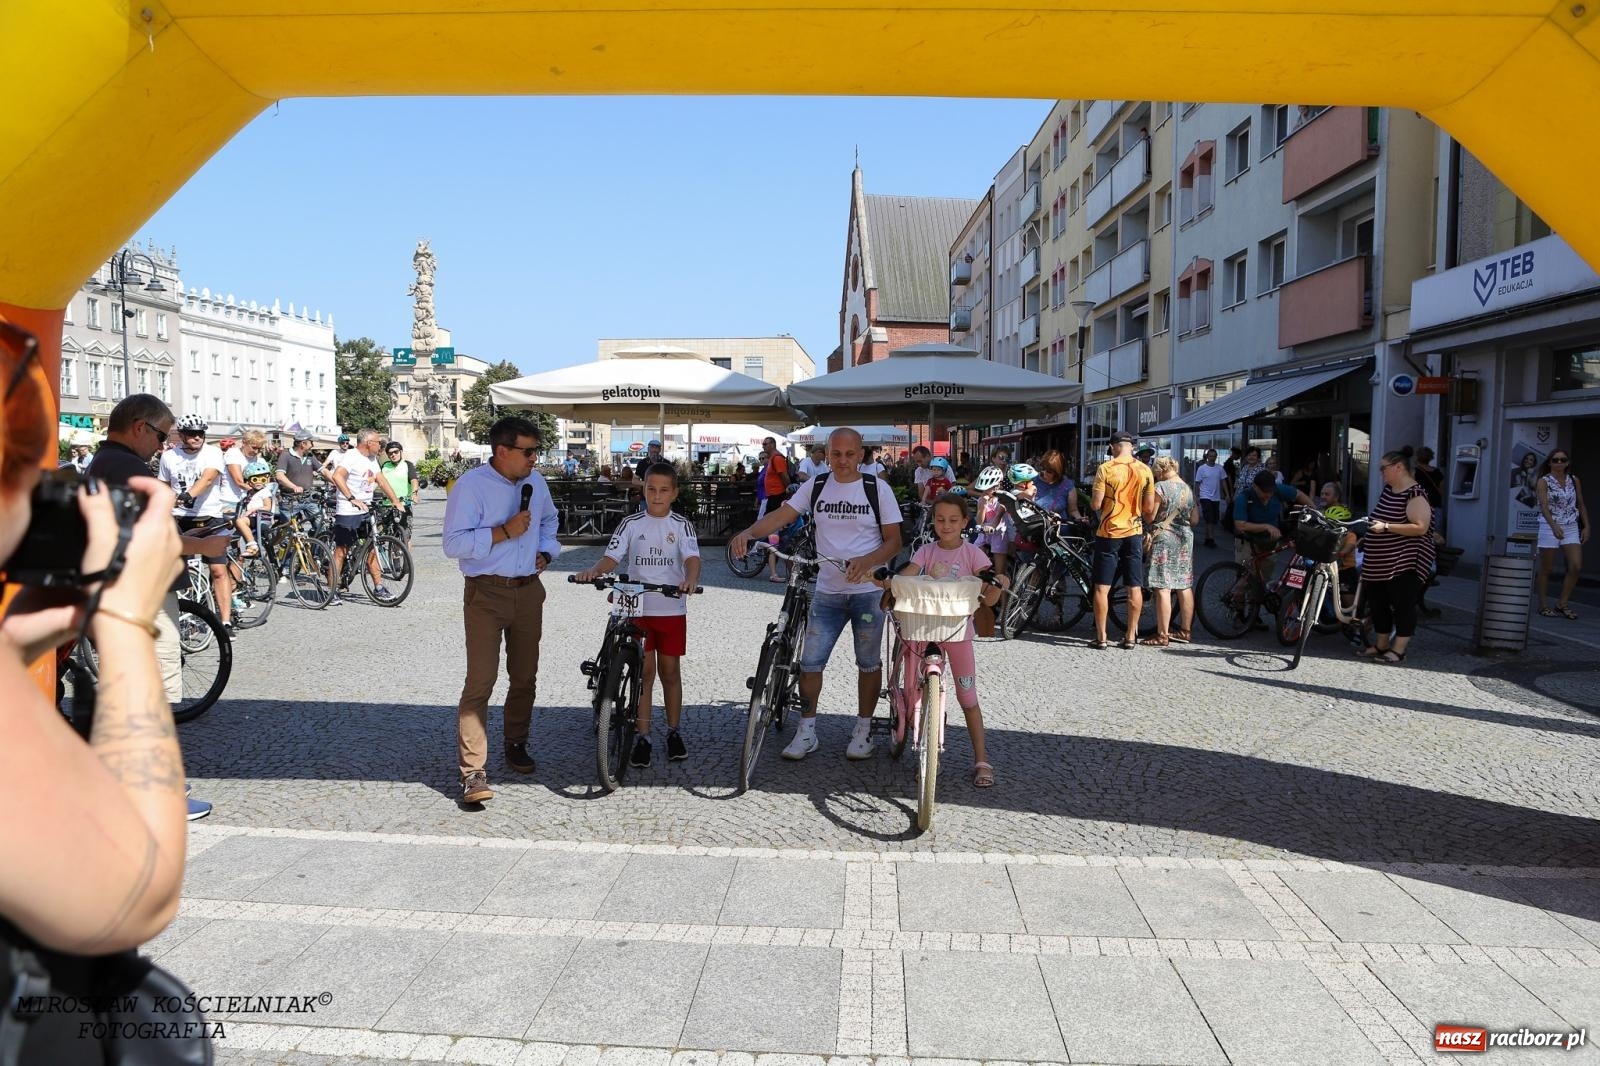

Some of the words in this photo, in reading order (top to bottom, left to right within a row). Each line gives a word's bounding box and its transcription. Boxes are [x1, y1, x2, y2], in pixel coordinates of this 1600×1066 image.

[1500, 250, 1535, 281] TEB
[1498, 278, 1533, 296] EDUKACJA
[602, 385, 661, 401] gelatopiu
[904, 383, 965, 399] gelatopiu
[1140, 404, 1158, 426] empik
[816, 500, 870, 515] Confident
[649, 547, 662, 556] Fly
[635, 556, 674, 566] Emirates
